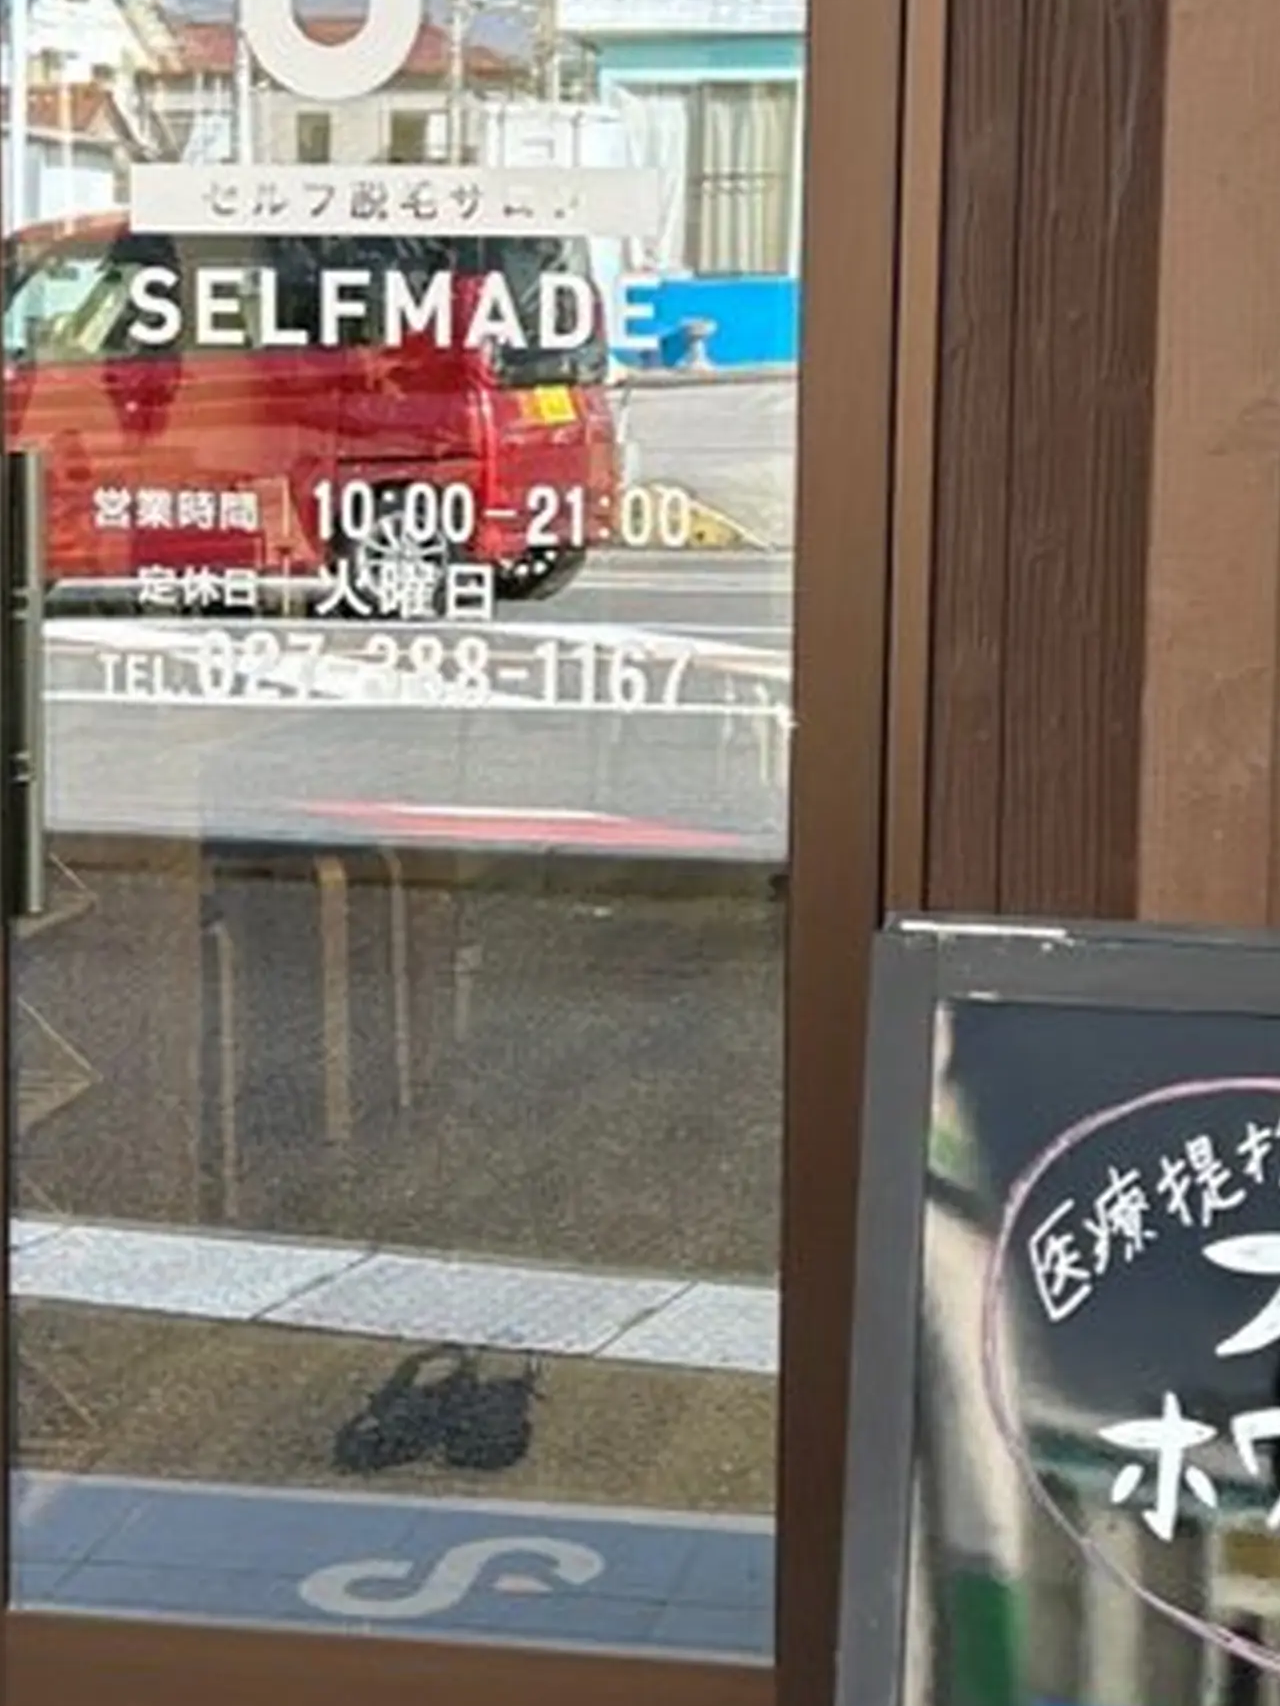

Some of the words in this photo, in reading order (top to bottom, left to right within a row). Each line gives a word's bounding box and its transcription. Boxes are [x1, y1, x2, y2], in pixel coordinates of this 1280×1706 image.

[129, 268, 662, 351] SELFMADE
[93, 488, 260, 534] 営業時間
[136, 566, 260, 610] 定休日
